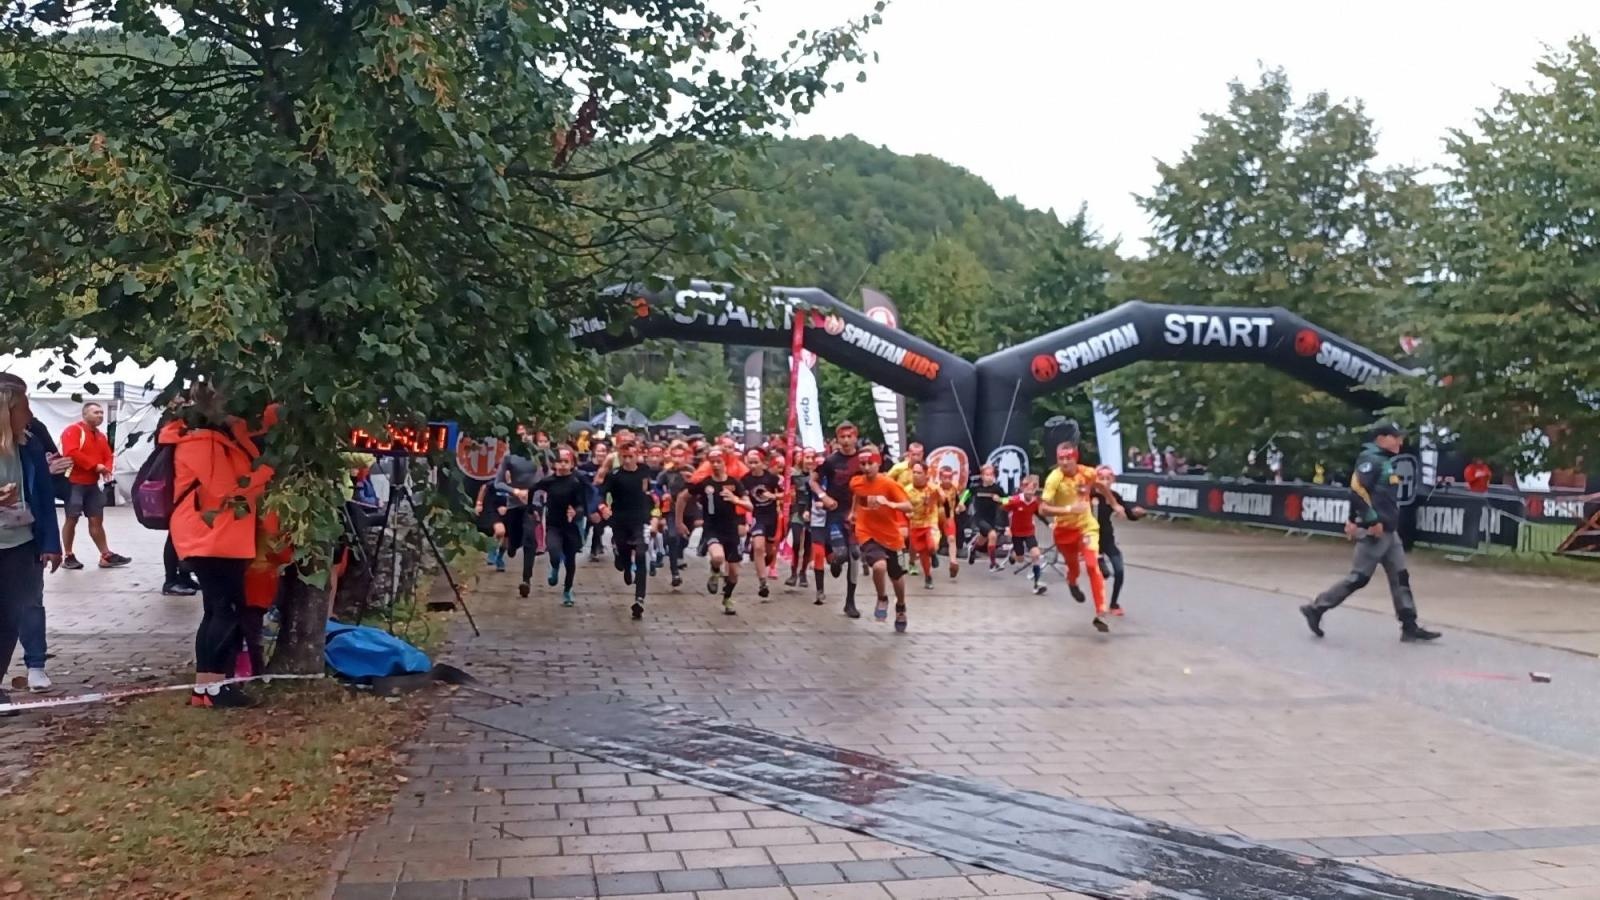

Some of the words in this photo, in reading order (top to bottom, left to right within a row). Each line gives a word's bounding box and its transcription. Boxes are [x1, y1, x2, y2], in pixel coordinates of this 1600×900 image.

[1164, 313, 1275, 347] START
[1054, 322, 1140, 373] SPARTAN
[1316, 341, 1388, 384] SPARTA
[745, 376, 762, 433] START
[1223, 491, 1273, 517] SPARTAN
[1301, 495, 1350, 524] SPARTA
[1416, 505, 1465, 536] ARTAN
